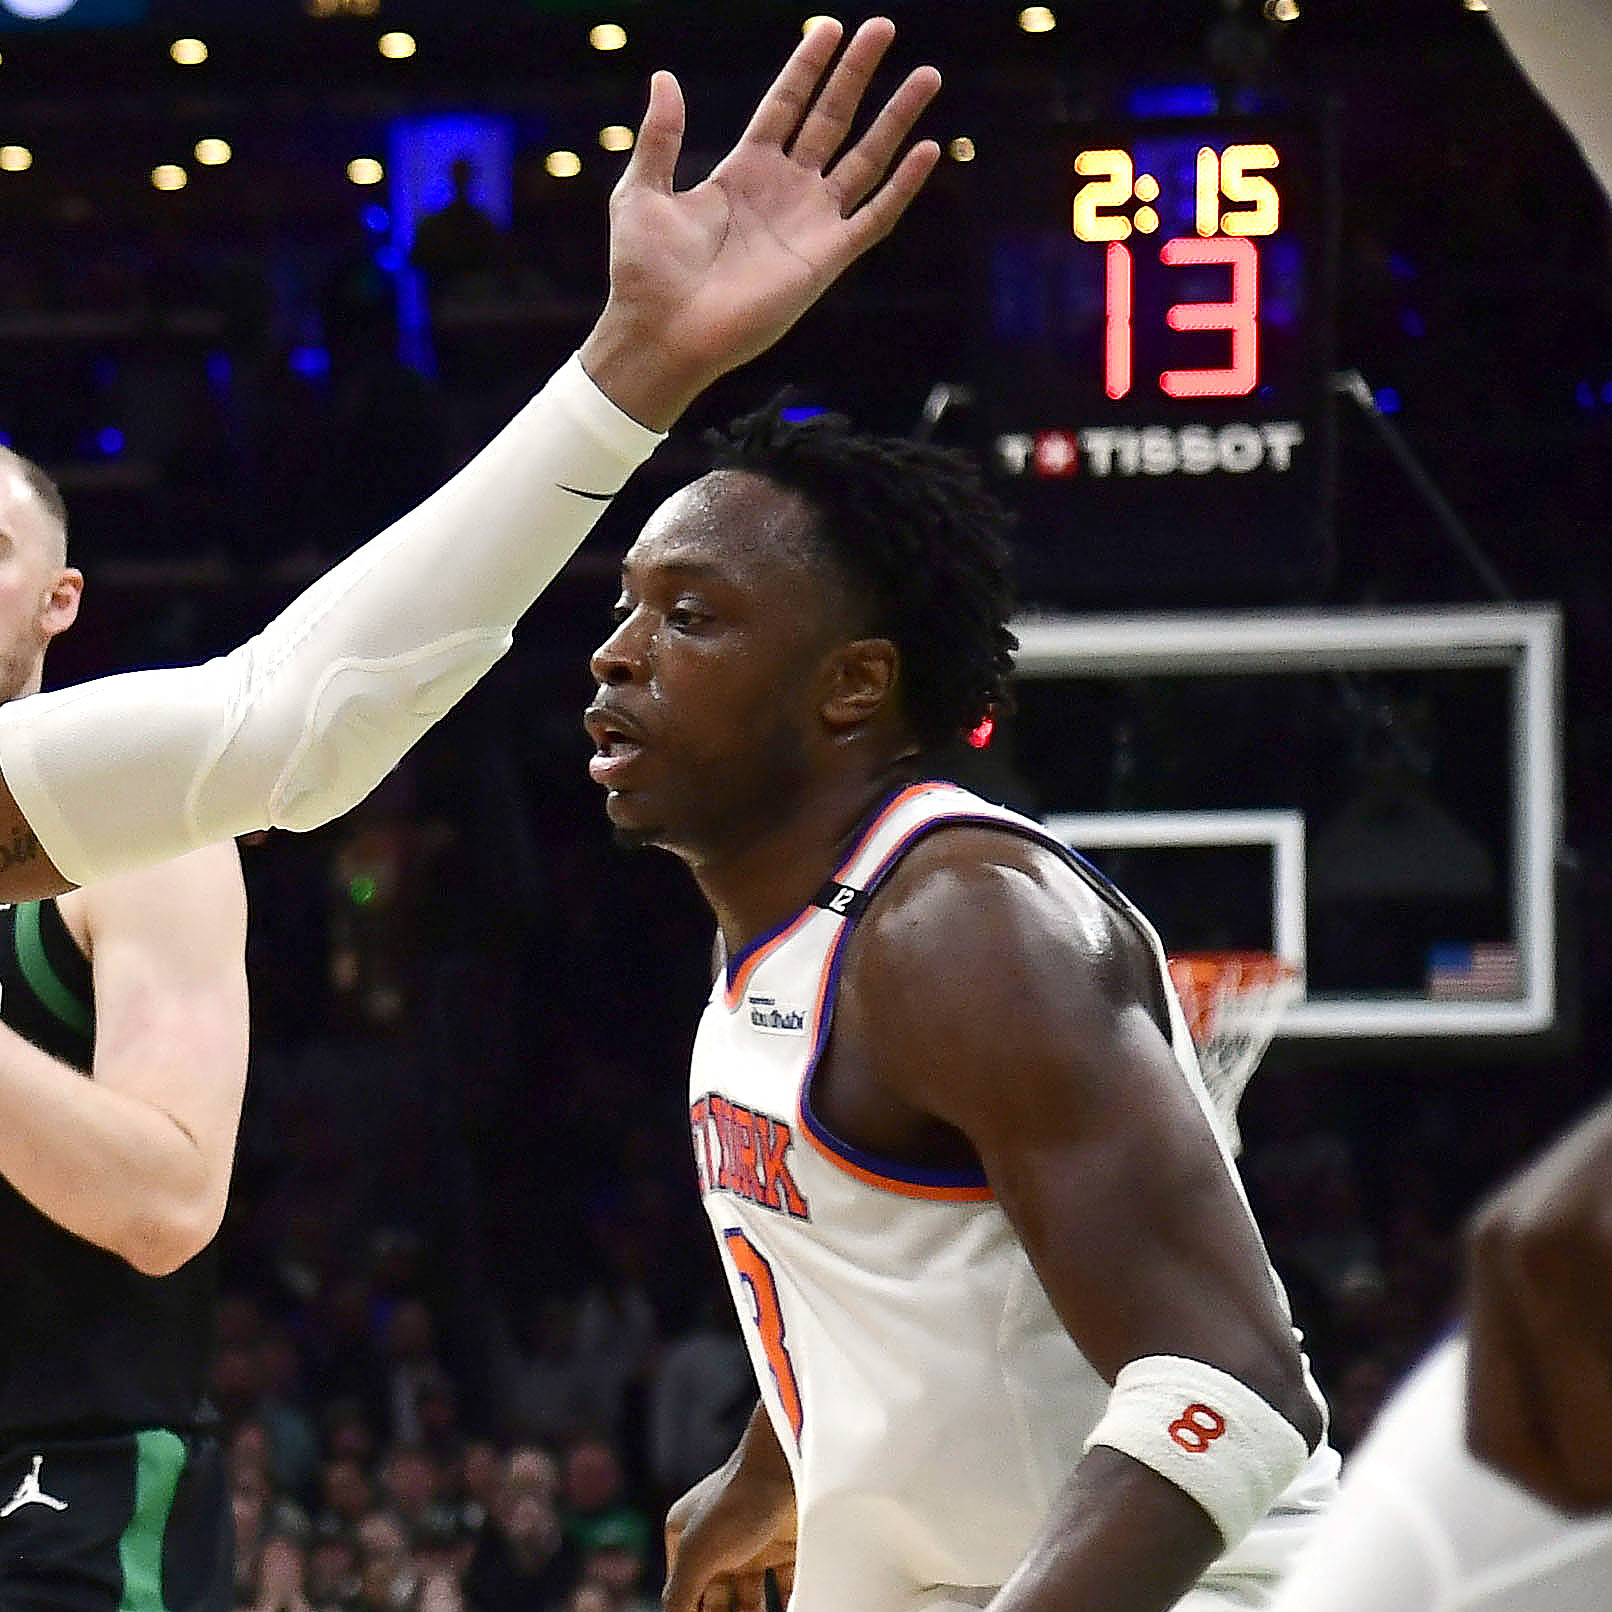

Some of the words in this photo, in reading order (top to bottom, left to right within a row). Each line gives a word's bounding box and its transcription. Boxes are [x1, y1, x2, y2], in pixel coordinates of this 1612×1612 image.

[1073, 143, 1280, 242] 2:15
[1106, 236, 1259, 400] 13
[1168, 1403, 1225, 1453] 8
